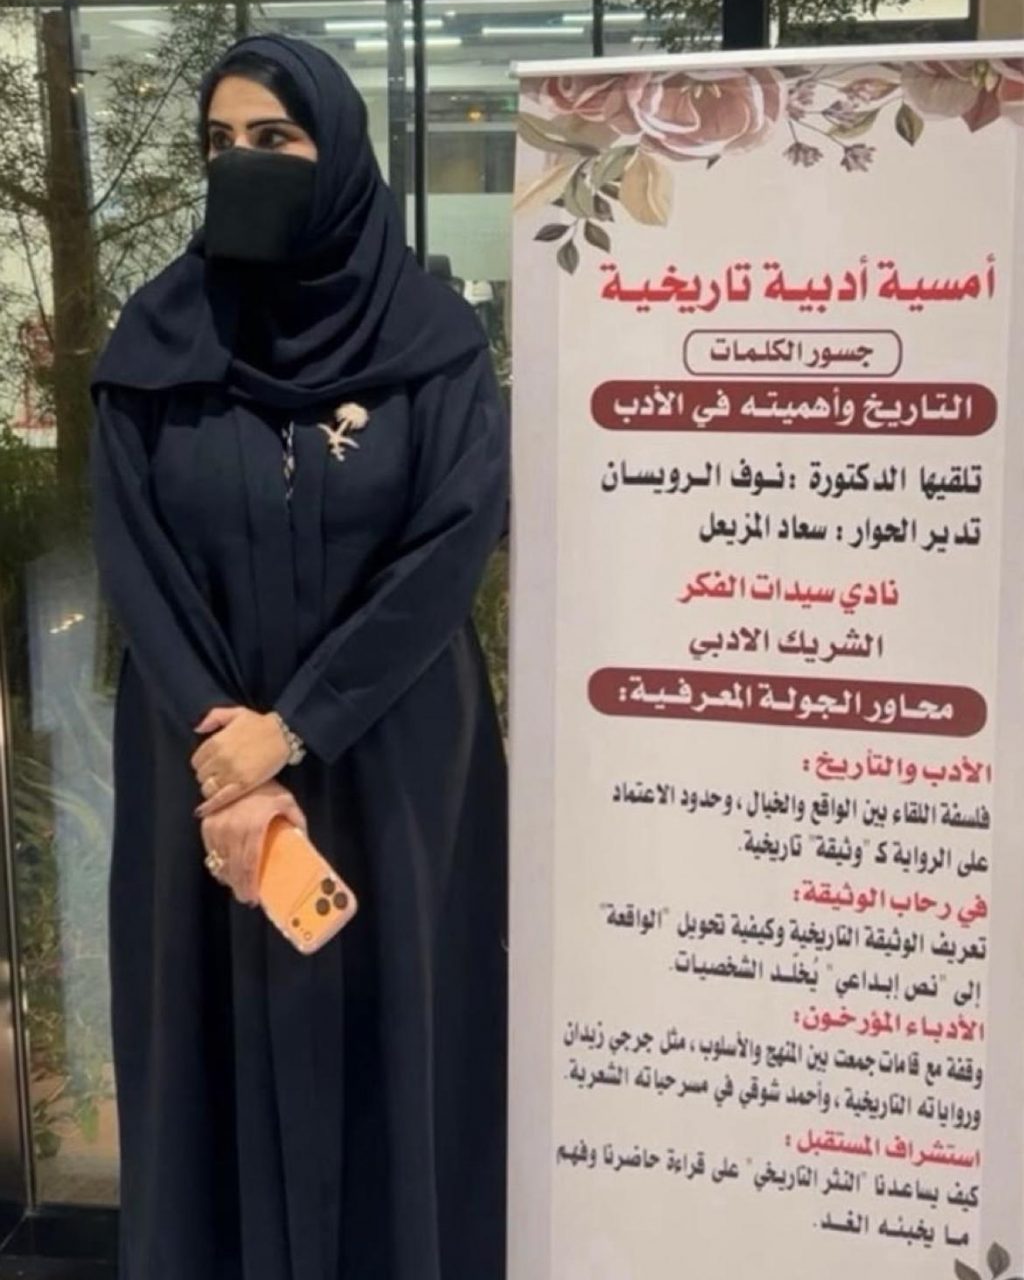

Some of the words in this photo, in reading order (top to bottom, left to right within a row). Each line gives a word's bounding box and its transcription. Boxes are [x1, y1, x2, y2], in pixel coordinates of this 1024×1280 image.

[599, 261, 753, 315] تاريخية
[762, 254, 869, 314] أدبية
[876, 253, 996, 313] أمسية
[709, 337, 803, 363] الكلمات
[806, 344, 875, 369] جسور
[613, 391, 684, 416] الأدب
[692, 387, 731, 427] في
[739, 391, 855, 424] وأهميته
[863, 393, 973, 428] التاريخ
[600, 459, 722, 495] الرويسان
[808, 460, 907, 500] الدكتورة
[919, 464, 983, 502] تلقيها
[698, 510, 771, 547] المزيعل
[776, 514, 828, 541] سعاد
[847, 516, 918, 551] الحوار
[920, 516, 982, 554] تدير
[676, 569, 747, 605] الفكر
[749, 573, 836, 610] سيدات
[838, 578, 900, 616] نادي
[776, 627, 884, 663] الشريك
[758, 684, 862, 719] الجولة
[865, 694, 955, 722] محاور
[921, 755, 992, 788] الأدب
[611, 781, 676, 806] الاعتماد
[679, 788, 734, 817] وحدود
[745, 789, 806, 823] والخيال
[809, 797, 858, 827] الواقع
[861, 798, 888, 829] بين
[891, 801, 937, 826] اللقاء
[939, 801, 991, 830] فلسفة
[891, 840, 952, 875] الرواية
[956, 849, 989, 879] على
[889, 891, 953, 921] رحاب
[956, 894, 989, 929] في
[676, 911, 726, 941] تحويل
[730, 913, 786, 948] وكيفية
[788, 918, 860, 952] التاريخية
[863, 925, 925, 960] الوثيقة
[930, 936, 987, 965] تعريف
[952, 979, 981, 1008] إلى
[563, 1020, 605, 1050] زيدان
[608, 1030, 655, 1056] جرجي
[659, 1027, 687, 1056] مثل
[905, 1013, 985, 1044] الأدباء
[698, 1031, 763, 1067] والأسلوب
[765, 1040, 803, 1069] المنهج
[805, 1044, 829, 1074] بين
[833, 1048, 877, 1078] جمعت
[878, 1050, 921, 1077] قامات
[633, 1069, 709, 1099] مسرحياته
[924, 1061, 943, 1087] مع
[946, 1057, 984, 1090] وقفة
[713, 1074, 735, 1108] في
[738, 1075, 781, 1110] شوقي
[785, 1081, 832, 1115] وأحمد
[844, 1086, 912, 1120] التاريخية
[916, 1095, 982, 1132] ورواياته
[556, 1139, 598, 1170] وفهم
[602, 1143, 661, 1172] حاضرنا
[795, 1129, 881, 1157] المستقبل
[884, 1135, 981, 1168] استشراف
[666, 1148, 706, 1181] قراءة
[711, 1157, 740, 1185] على
[874, 1173, 940, 1210] يساعدنا
[946, 1181, 979, 1213] كيف
[944, 1224, 970, 1247] ما
